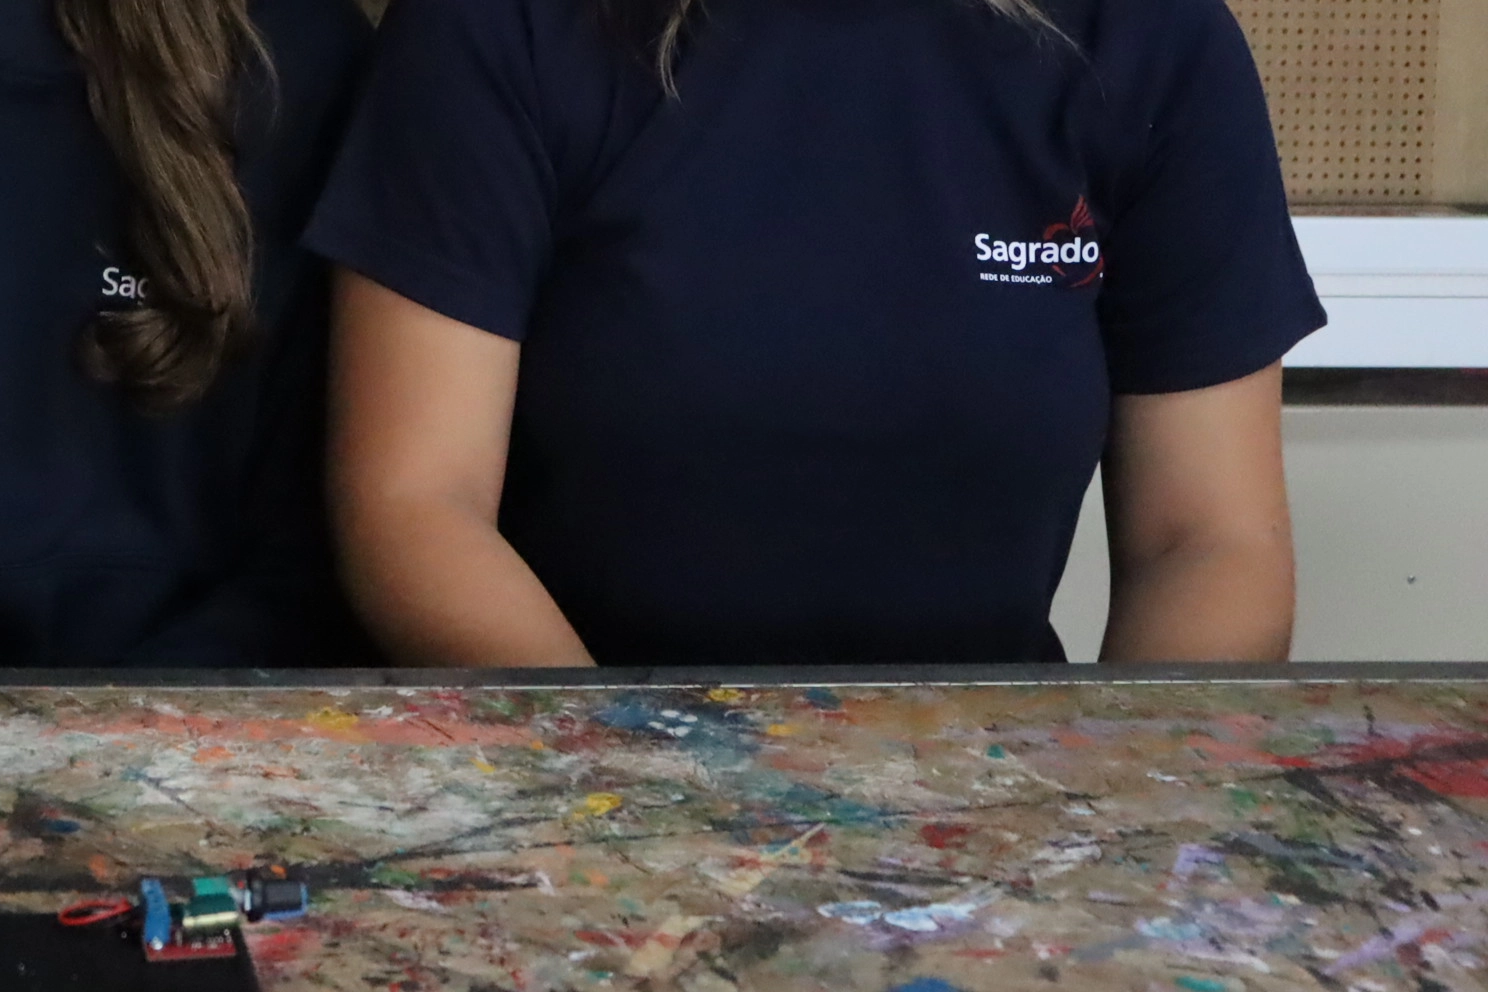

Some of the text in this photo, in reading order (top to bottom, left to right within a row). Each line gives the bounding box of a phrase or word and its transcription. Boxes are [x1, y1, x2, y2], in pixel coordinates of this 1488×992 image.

[974, 233, 1100, 271] Sagrado
[979, 272, 1053, 284] REDE DE EDUCAÇÃO
